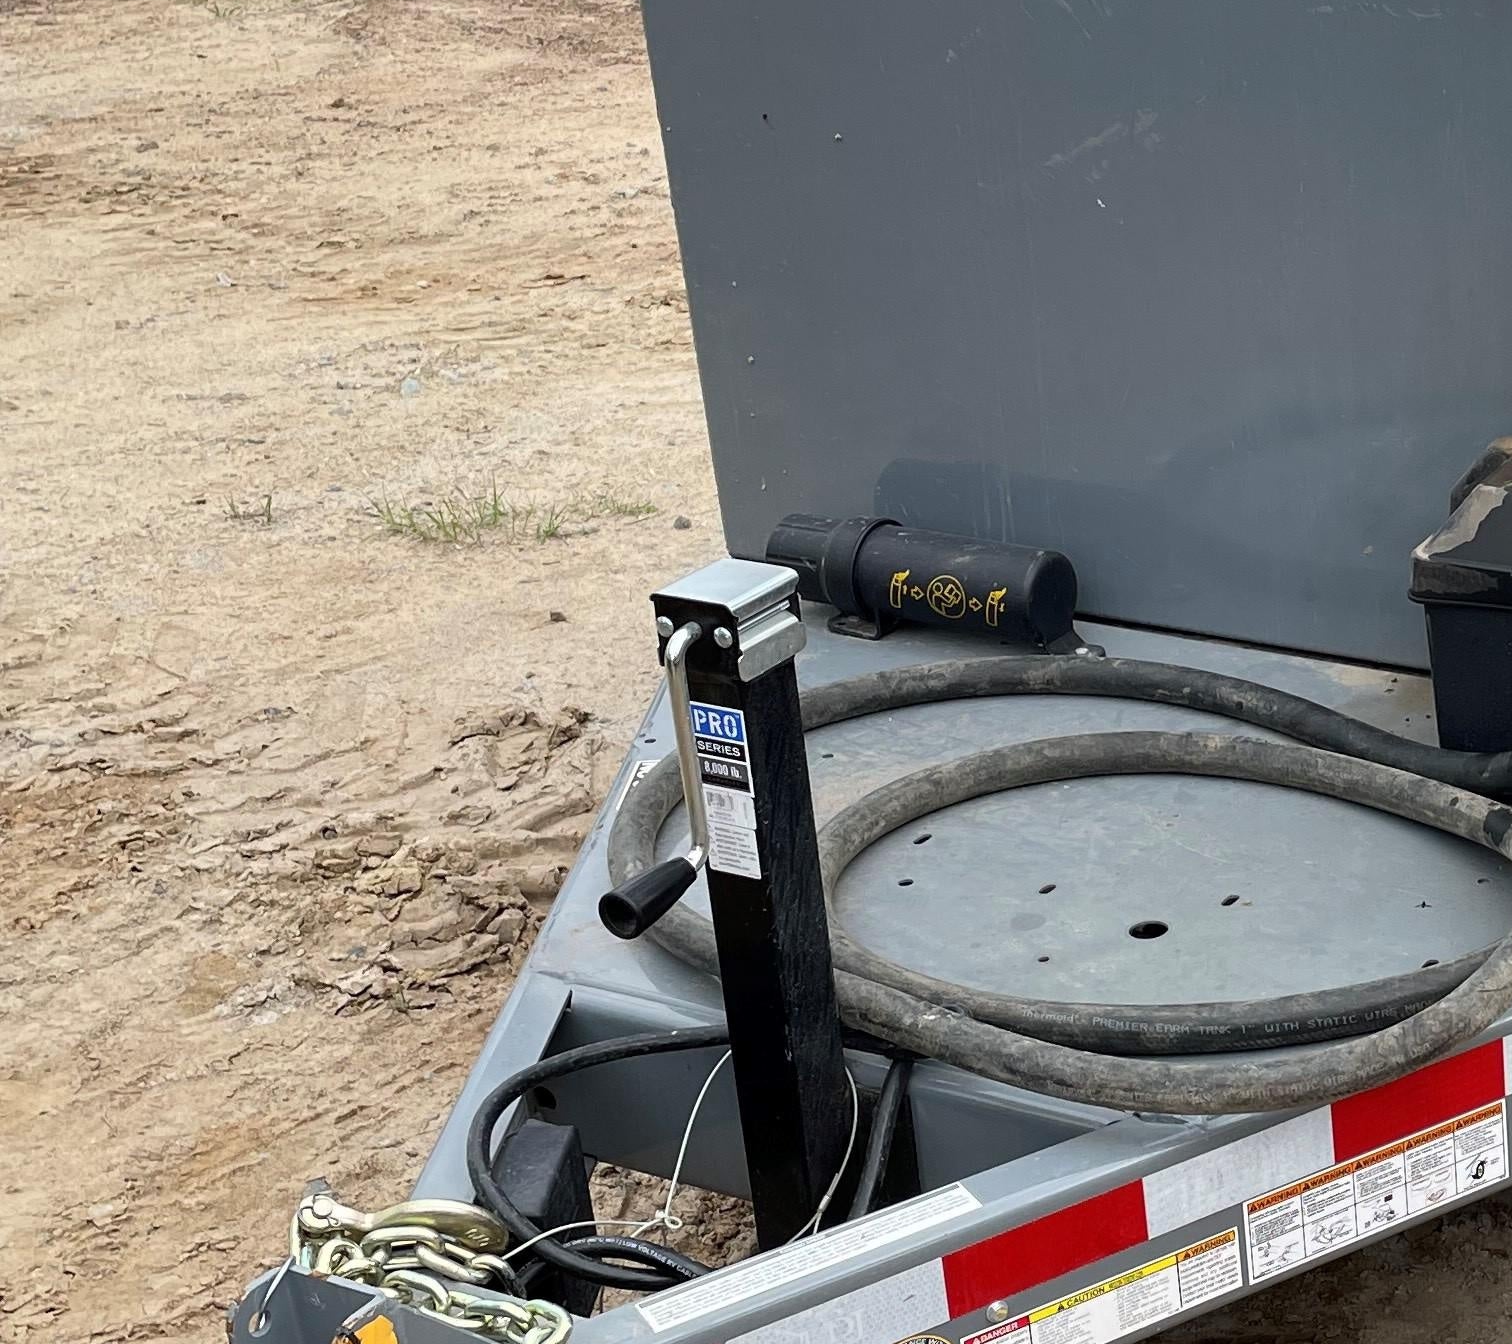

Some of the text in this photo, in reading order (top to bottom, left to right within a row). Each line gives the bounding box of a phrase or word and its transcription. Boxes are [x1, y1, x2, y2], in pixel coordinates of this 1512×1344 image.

[693, 708, 738, 739] PRO
[697, 740, 741, 757] SERIES
[703, 760, 743, 779] 8,000 lb.
[1092, 1016, 1149, 1033] PREMIER
[1199, 1024, 1232, 1035] TANK
[1265, 1020, 1299, 1033] WITH
[1307, 1014, 1358, 1029] STATIC
[1365, 1007, 1397, 1022] WIRE
[1463, 1107, 1502, 1128] WARNING
[1411, 1126, 1452, 1148] WARNING
[1359, 1146, 1403, 1168] WARNING
[1309, 1167, 1352, 1189] WARNING
[1256, 1187, 1299, 1209] WARNING
[638, 1244, 667, 1264] VOLTAGE
[1190, 1234, 1232, 1258] WARNING
[1066, 1285, 1106, 1308] CAUTION
[980, 1321, 1019, 1343] DANGER
